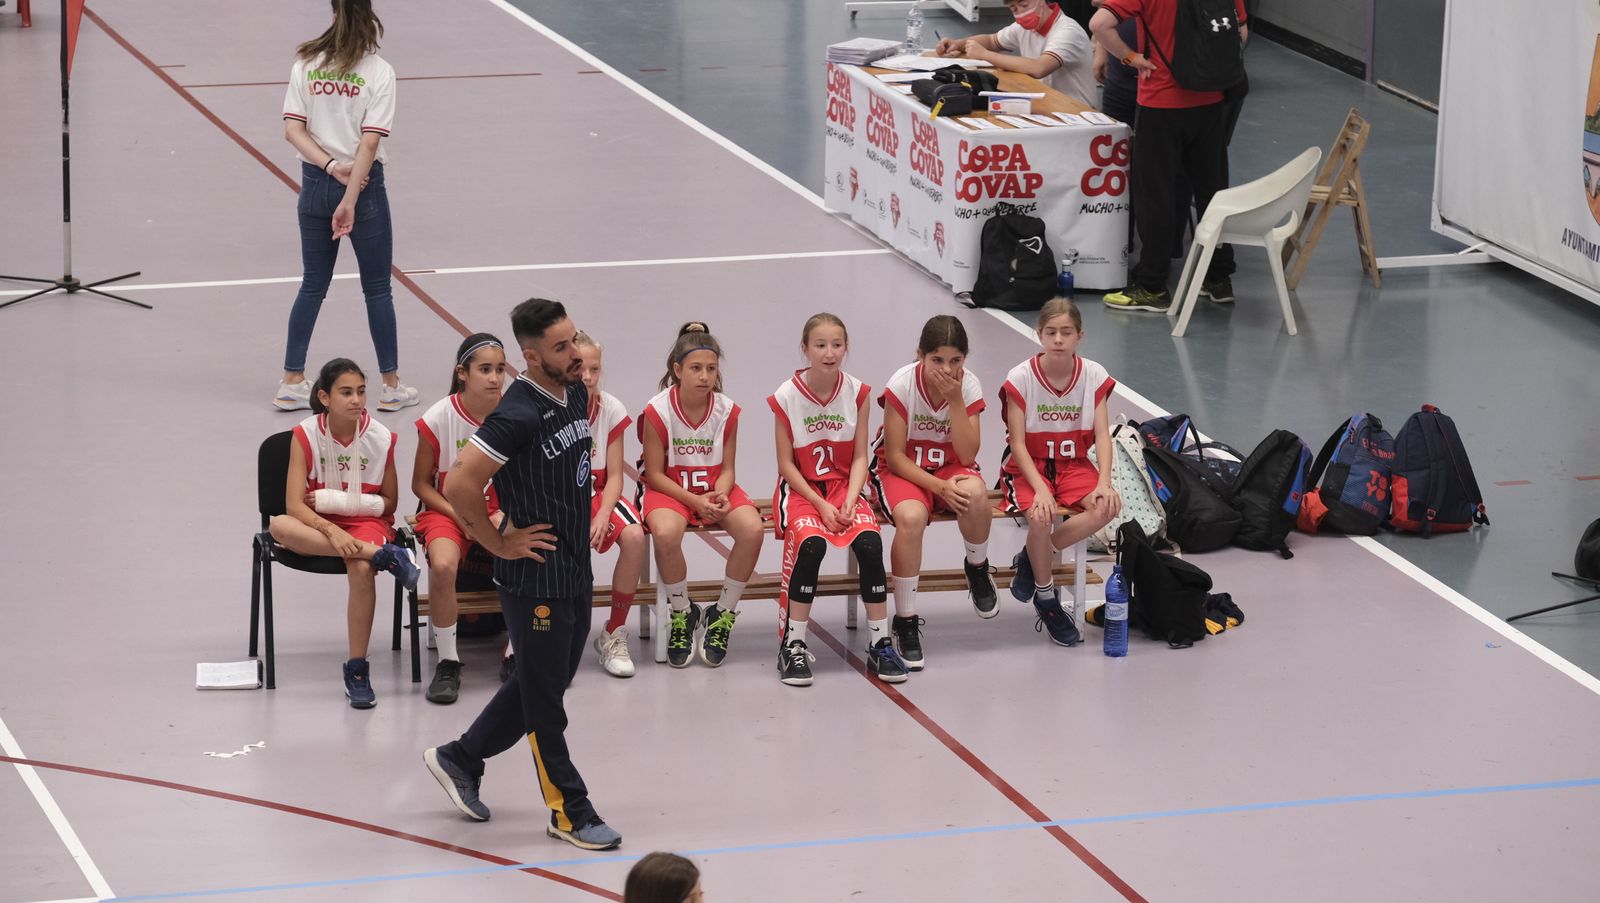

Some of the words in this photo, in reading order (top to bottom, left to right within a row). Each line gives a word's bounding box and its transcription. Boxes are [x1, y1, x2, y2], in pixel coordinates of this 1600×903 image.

[314, 81, 360, 98] COVAP
[827, 62, 852, 103] COPA
[868, 87, 895, 130] COPA
[866, 114, 899, 159] COVAP
[911, 112, 940, 157] COPA
[909, 140, 944, 187] COVAP
[958, 139, 1031, 173] COPA
[955, 170, 1043, 203] COVAP
[1080, 202, 1114, 214] MUCHO
[808, 421, 843, 433] COVAP
[1042, 412, 1080, 422] COVAP
[555, 423, 577, 450] TOYO
[542, 440, 561, 460] EL
[677, 446, 713, 456] COVAP
[914, 446, 945, 468] 19
[1046, 440, 1076, 459] 19
[577, 450, 590, 487] 6
[680, 470, 709, 491] 15
